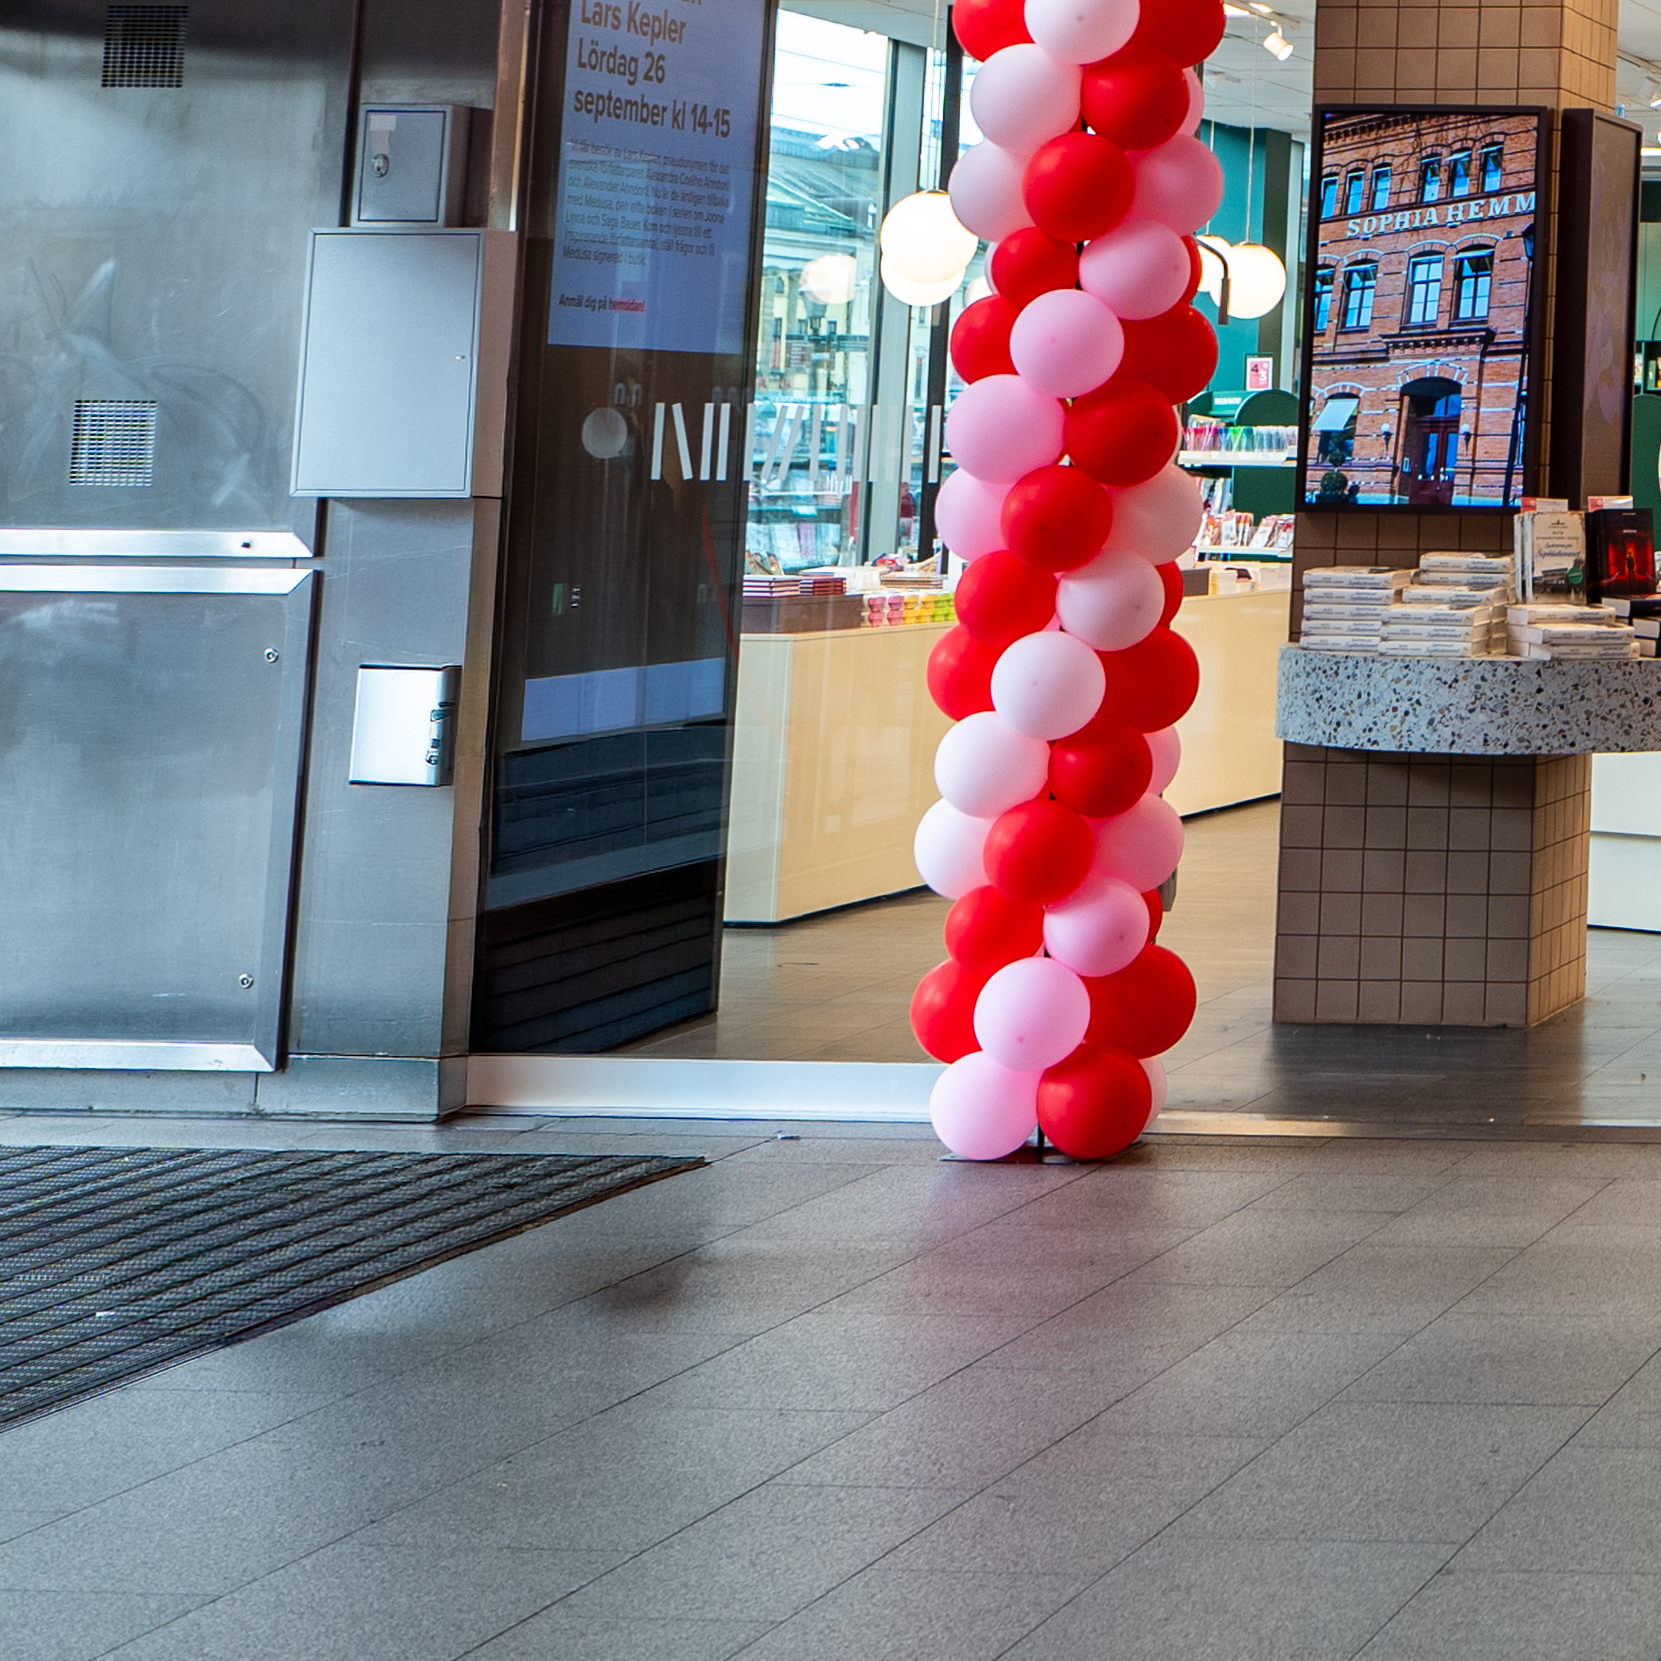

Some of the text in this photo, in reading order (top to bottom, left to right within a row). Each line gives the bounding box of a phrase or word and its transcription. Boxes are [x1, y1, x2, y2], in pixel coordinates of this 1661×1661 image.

[627, 0, 686, 46] Kepler
[577, 37, 666, 86] Lördag 26
[573, 89, 731, 138] september kl 14-15
[1347, 191, 1536, 237] SOPHIA HEMM
